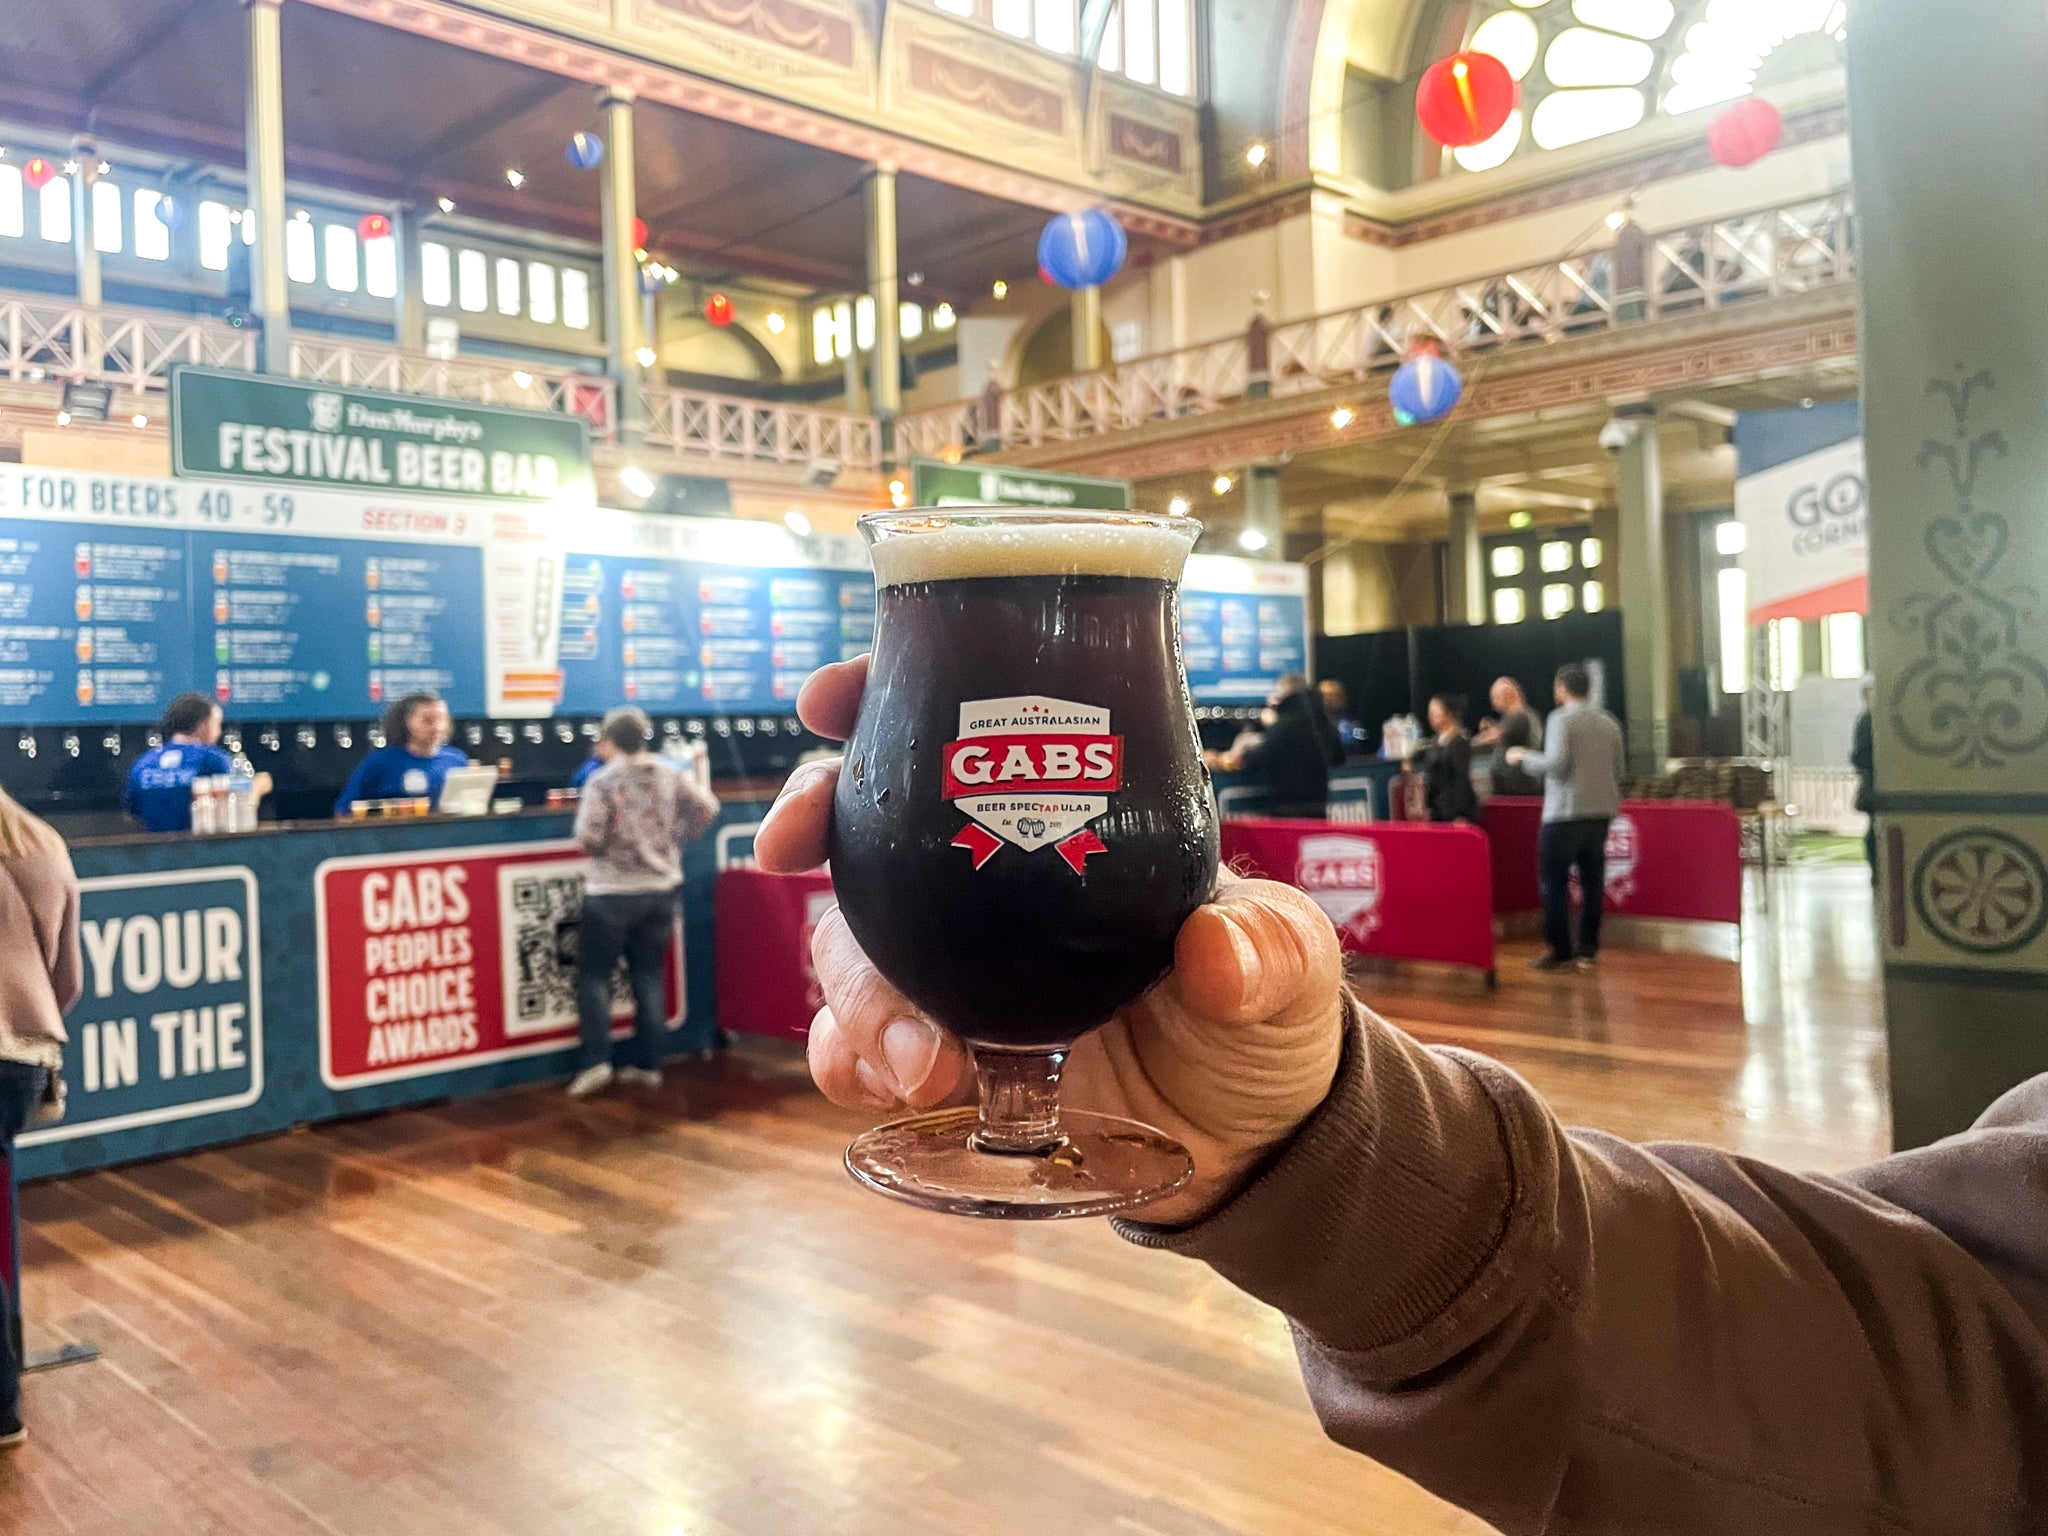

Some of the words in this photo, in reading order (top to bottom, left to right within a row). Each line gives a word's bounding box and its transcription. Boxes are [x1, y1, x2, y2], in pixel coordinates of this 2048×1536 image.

[218, 421, 391, 484] FESTIVAL
[397, 440, 486, 493] BEER
[22, 475, 76, 511] FOR
[90, 480, 178, 519] BEERS
[199, 488, 232, 522] 40
[262, 491, 296, 527] 59
[361, 507, 448, 532] SECTION
[969, 718, 1008, 730] GREAT
[1011, 715, 1101, 726] AUSTRALASIAN
[950, 743, 1114, 786] GABS
[976, 802, 1006, 813] BEER
[361, 864, 470, 933] GABS
[1301, 859, 1375, 886] GABS
[81, 907, 243, 999] YOUR
[365, 925, 474, 977] PEOPLES
[365, 965, 477, 1025] CHOICE
[82, 1017, 140, 1093] IN
[150, 1001, 247, 1081] THE
[367, 1009, 480, 1067] AWARDS
